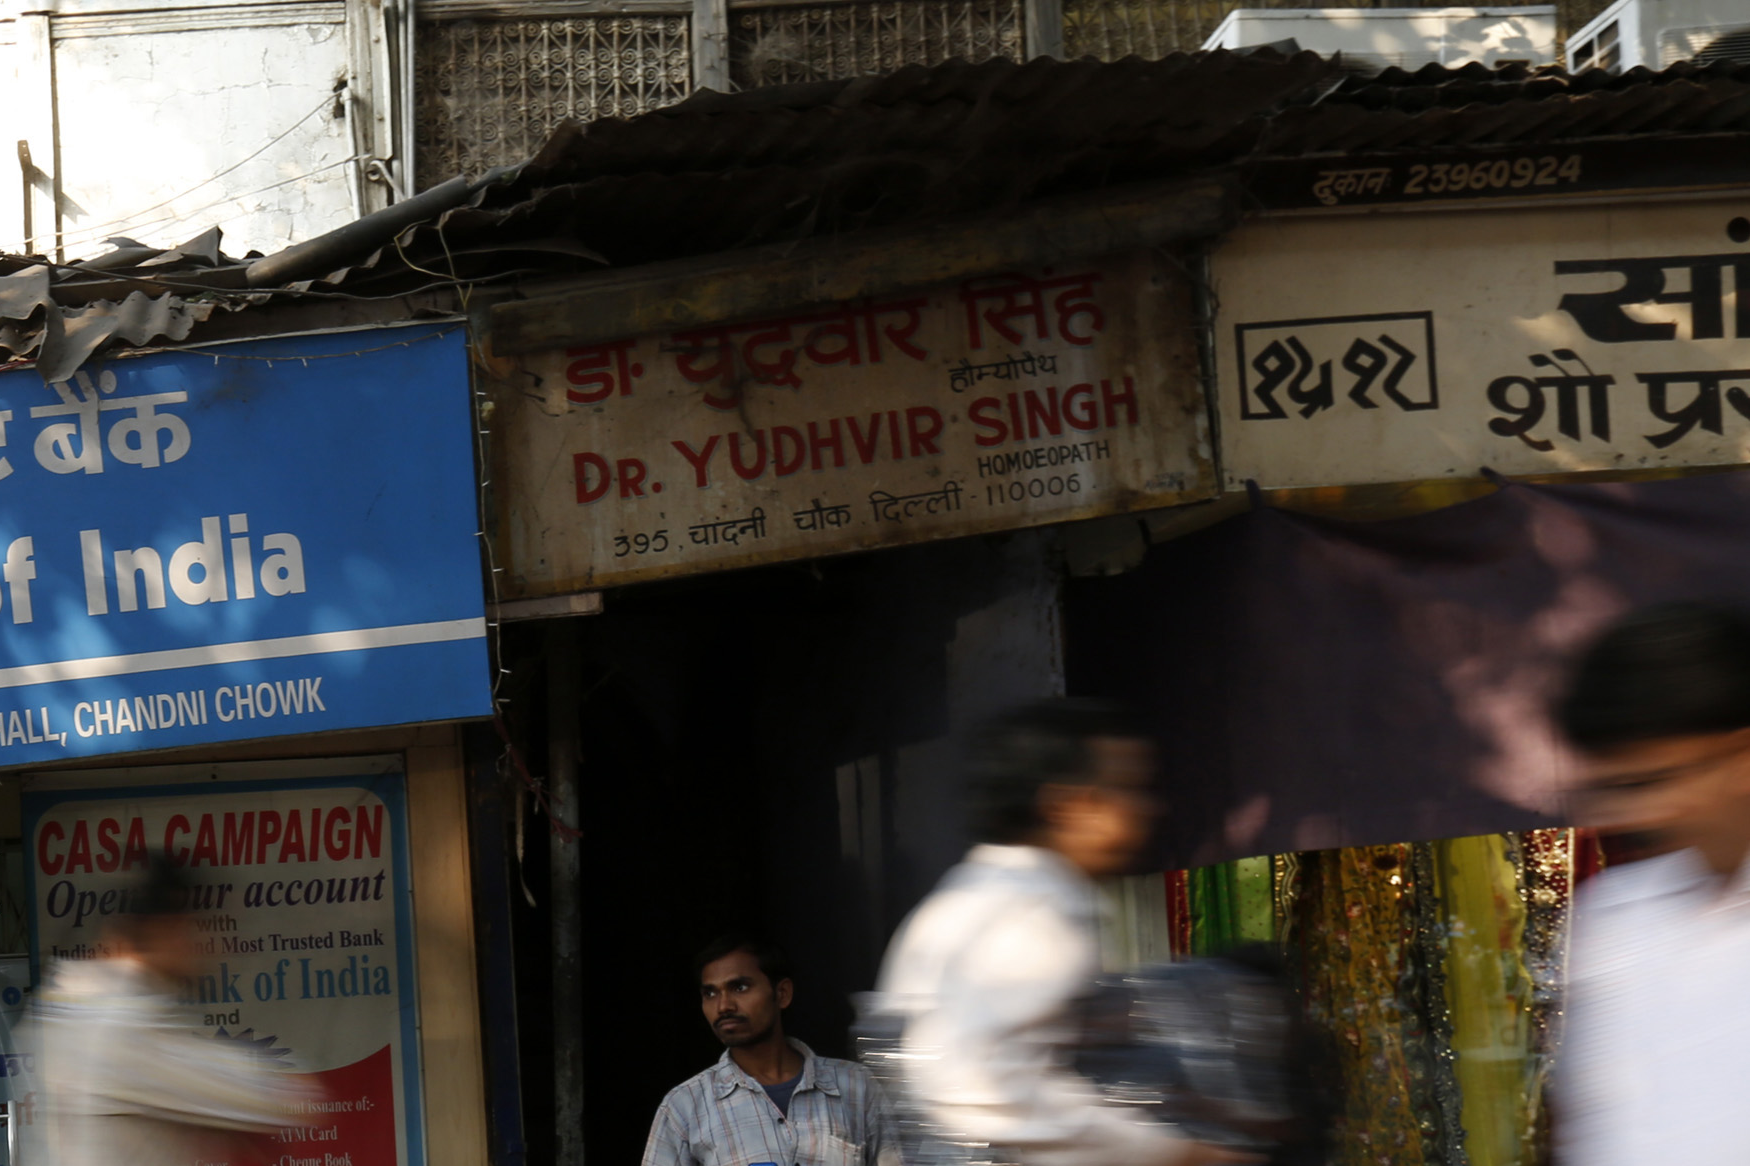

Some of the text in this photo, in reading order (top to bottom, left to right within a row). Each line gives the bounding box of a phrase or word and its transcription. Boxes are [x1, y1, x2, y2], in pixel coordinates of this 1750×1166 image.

[1402, 153, 1583, 196] 23960924
[30, 368, 192, 477] बैंक
[1634, 368, 1750, 450] प्र
[670, 404, 945, 490] YUDHVIR
[967, 376, 1139, 448] SINGH
[976, 439, 1111, 479] HOMOEOPATH
[79, 511, 308, 616] India
[72, 690, 208, 738] CHANDNI
[215, 676, 328, 724] CHOWK
[38, 804, 384, 876] CASA CAMPAIGN
[243, 868, 386, 908] account
[195, 914, 238, 933] with
[221, 936, 265, 954] Most
[268, 931, 334, 952] Trusted
[339, 929, 384, 948] Bank
[178, 953, 392, 1005] ank of India
[203, 1008, 241, 1027] and
[309, 1125, 339, 1143] Card
